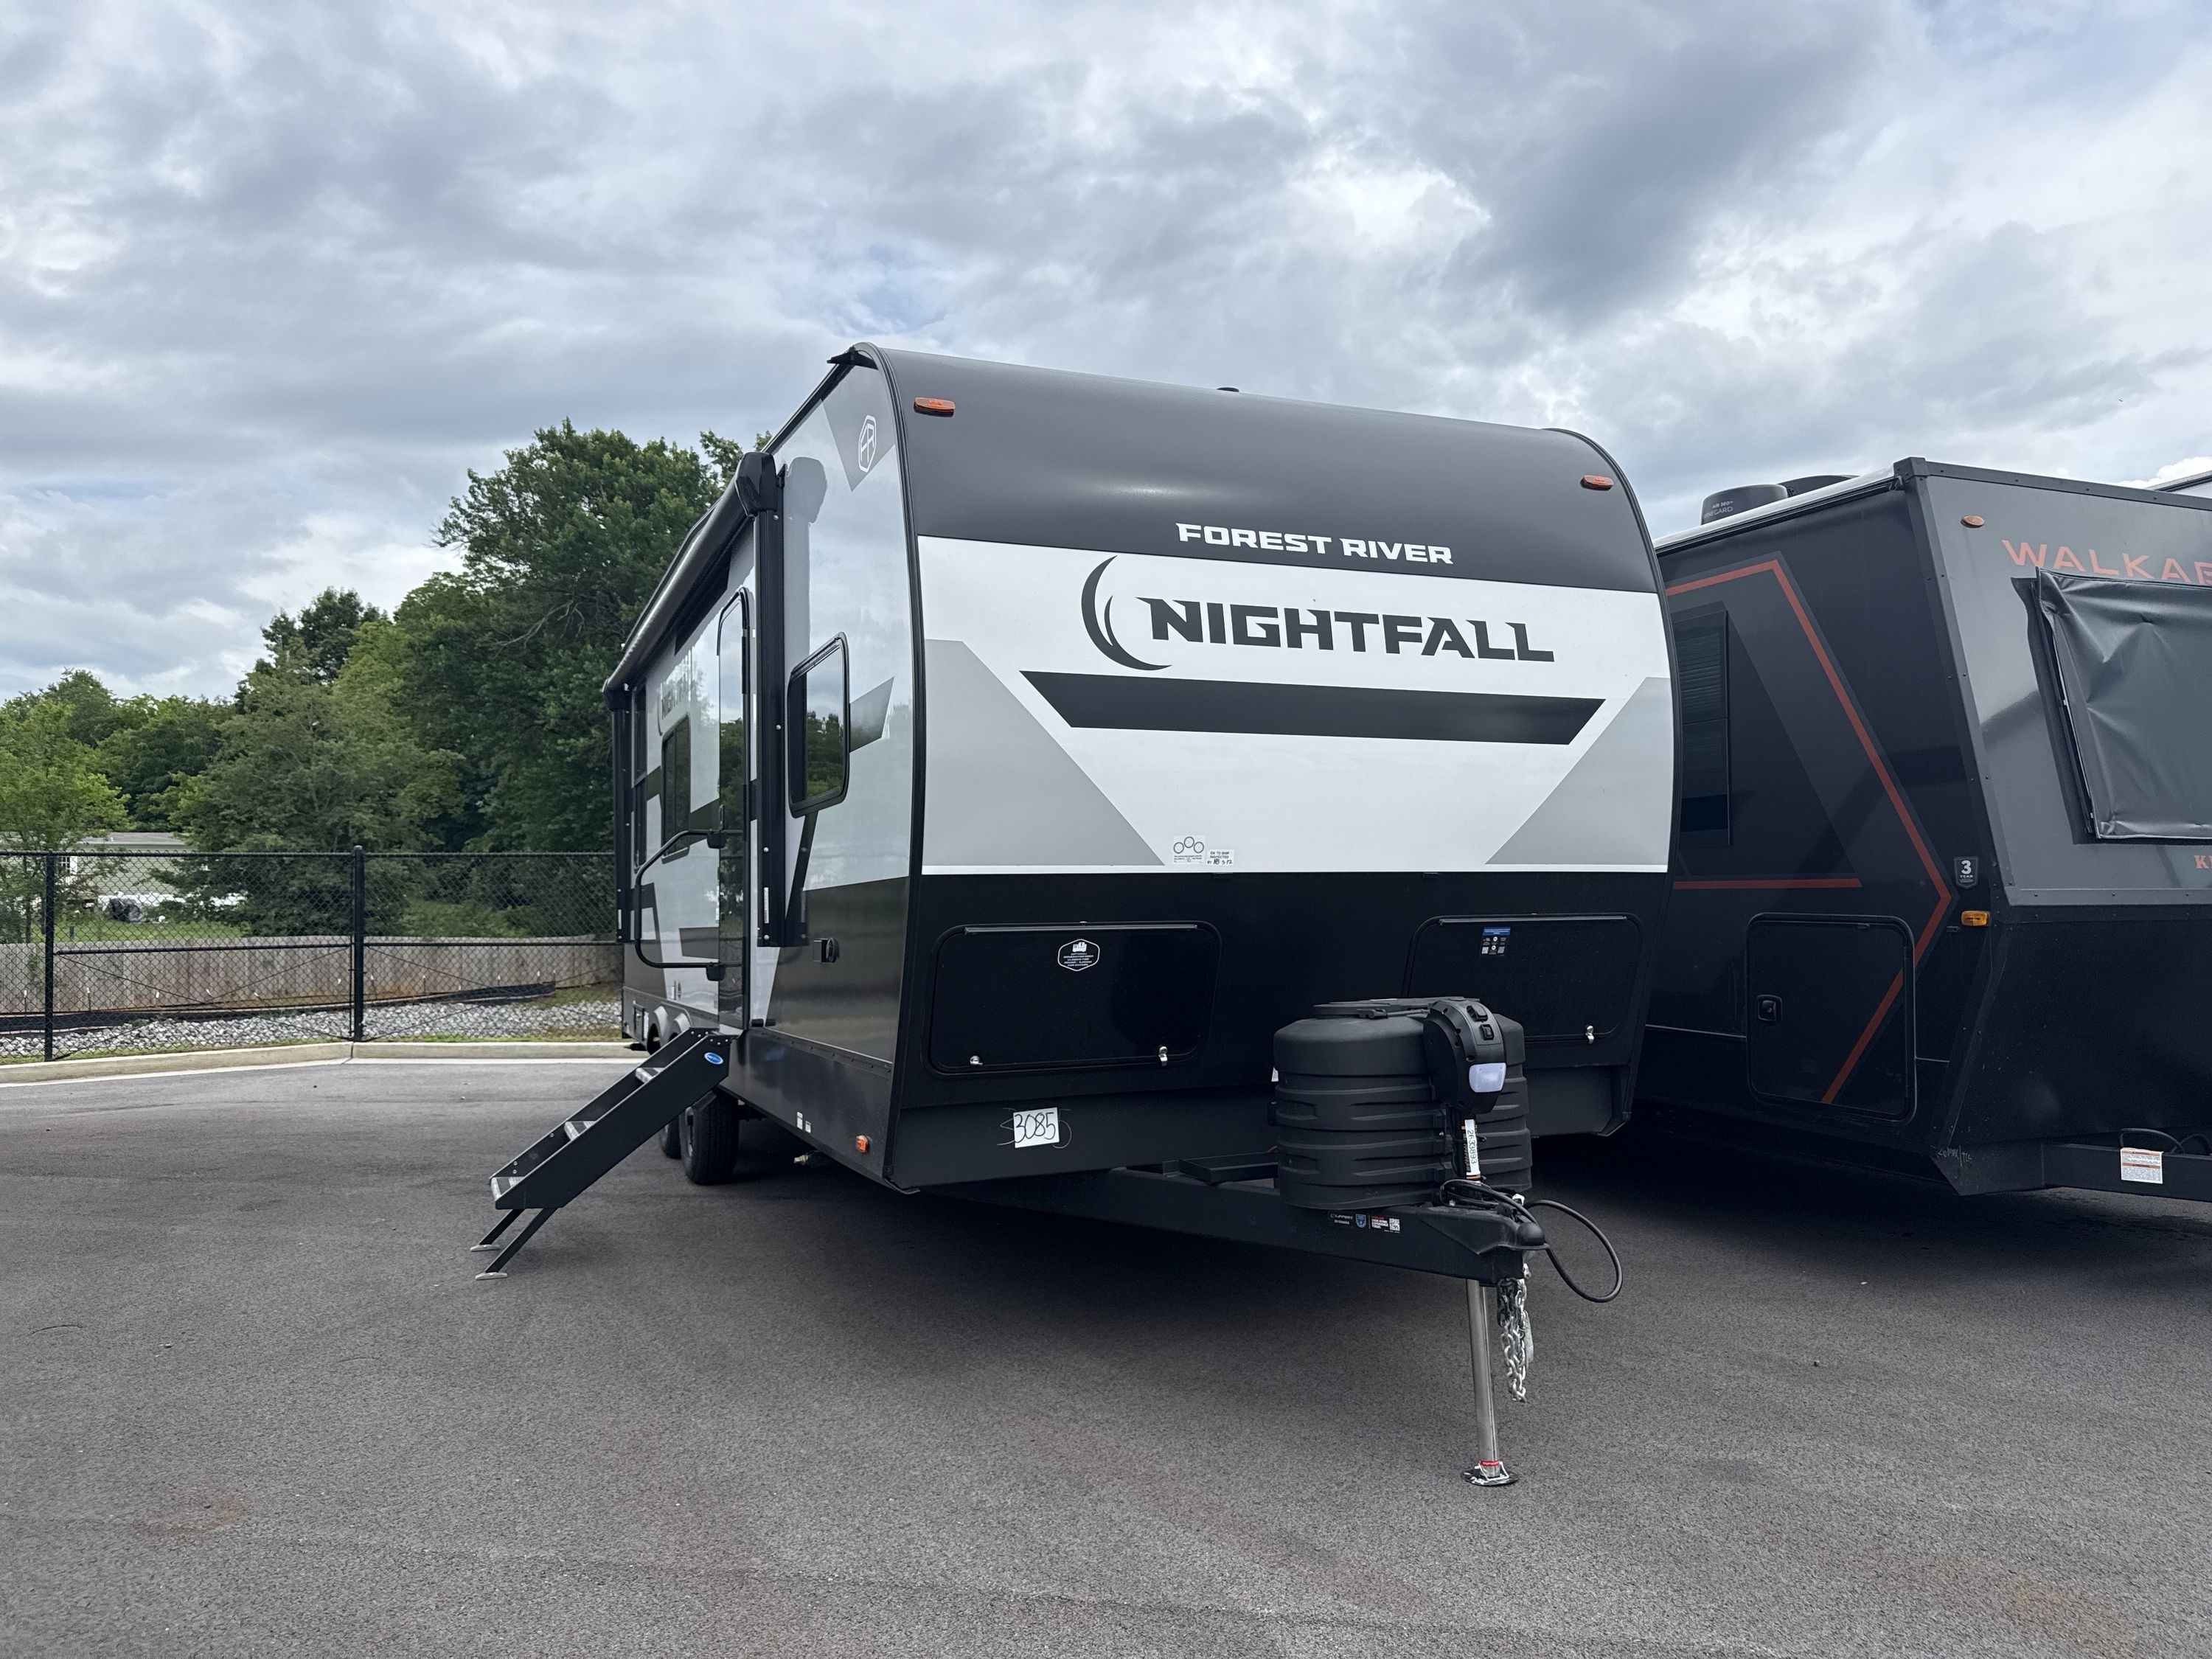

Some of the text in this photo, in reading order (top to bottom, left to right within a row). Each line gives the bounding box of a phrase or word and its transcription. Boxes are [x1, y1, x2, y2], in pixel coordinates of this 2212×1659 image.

[1175, 522, 1454, 565] FOREST RIVER
[1135, 597, 1555, 662] NIGHTFALL
[1961, 860, 1972, 874] 3
[1014, 1112, 1056, 1144] 3085
[1467, 1130, 1478, 1164] 2633893
